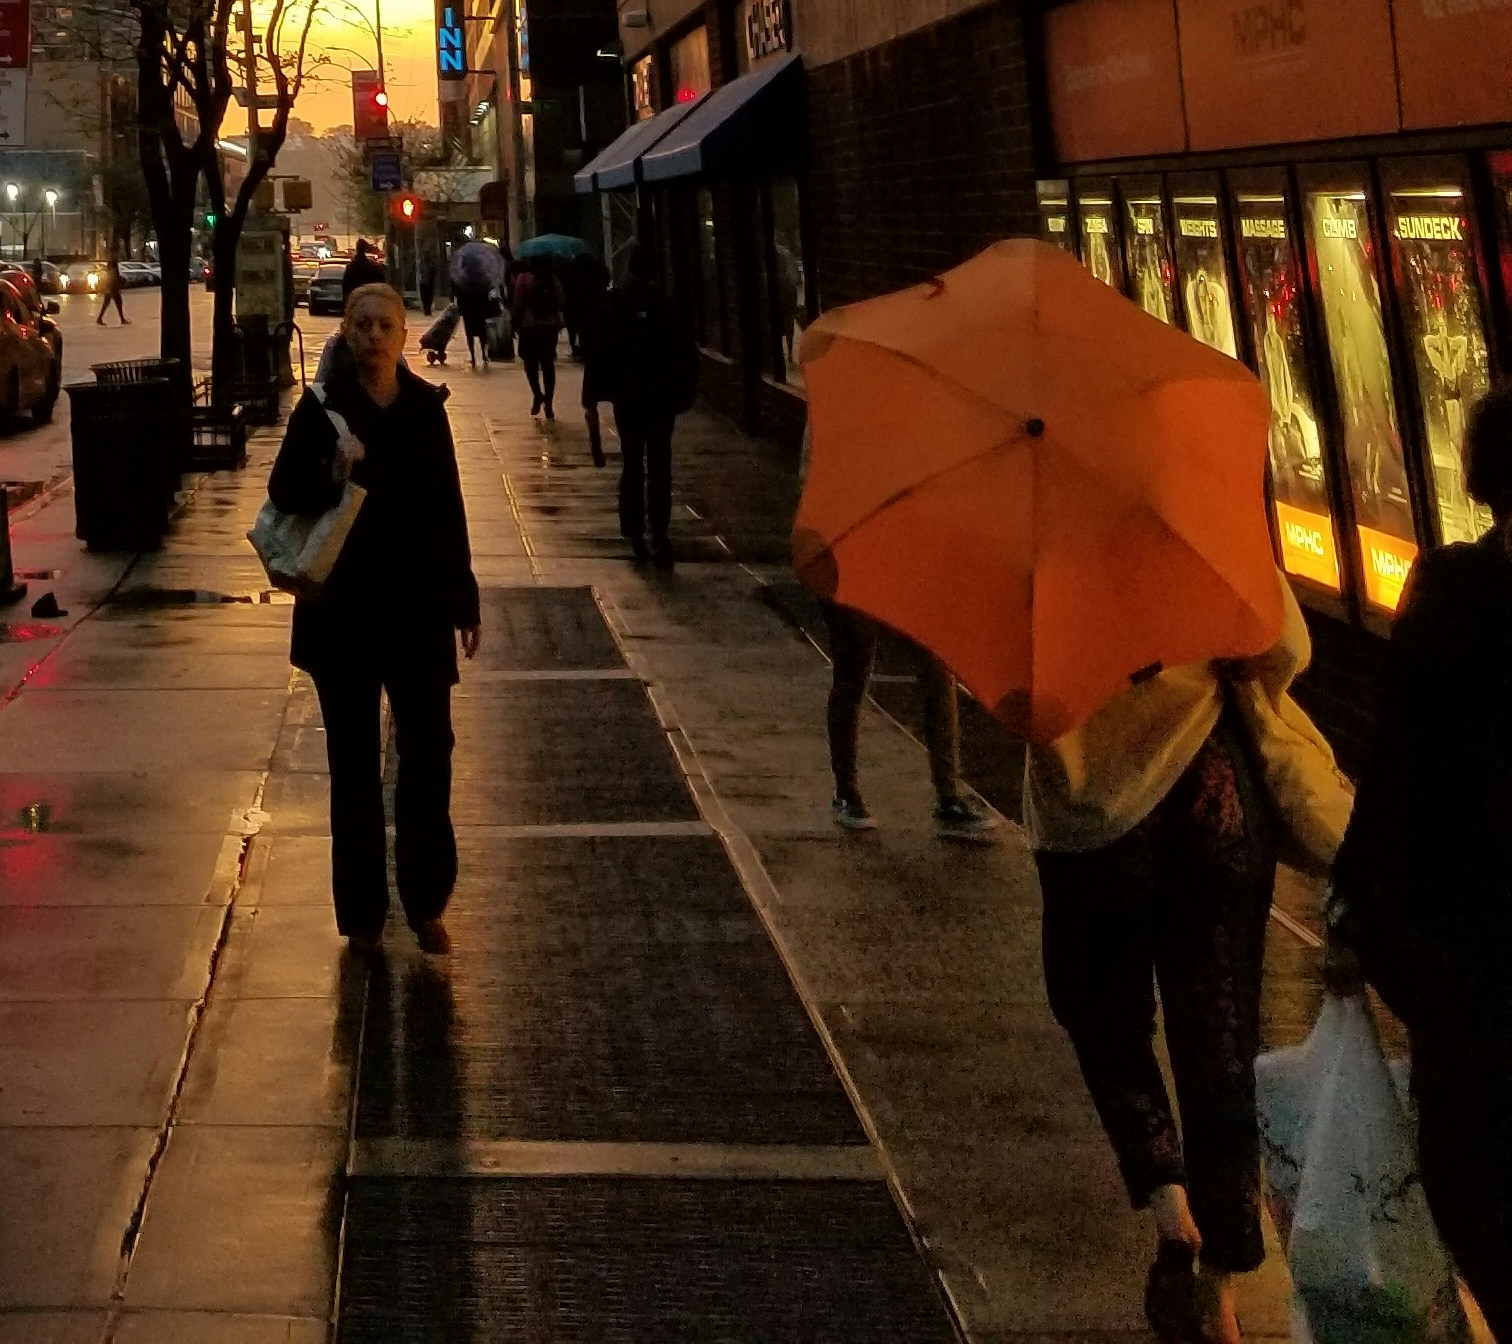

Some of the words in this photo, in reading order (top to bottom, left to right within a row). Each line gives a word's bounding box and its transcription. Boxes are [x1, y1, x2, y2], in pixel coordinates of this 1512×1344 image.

[440, 7, 463, 72] INN
[1179, 218, 1218, 238] WEIGHTS
[1241, 218, 1286, 239] MASSAGE
[1322, 218, 1357, 239] CLIMB
[1397, 215, 1463, 241] SUNDECK
[1284, 521, 1325, 557] MPHC
